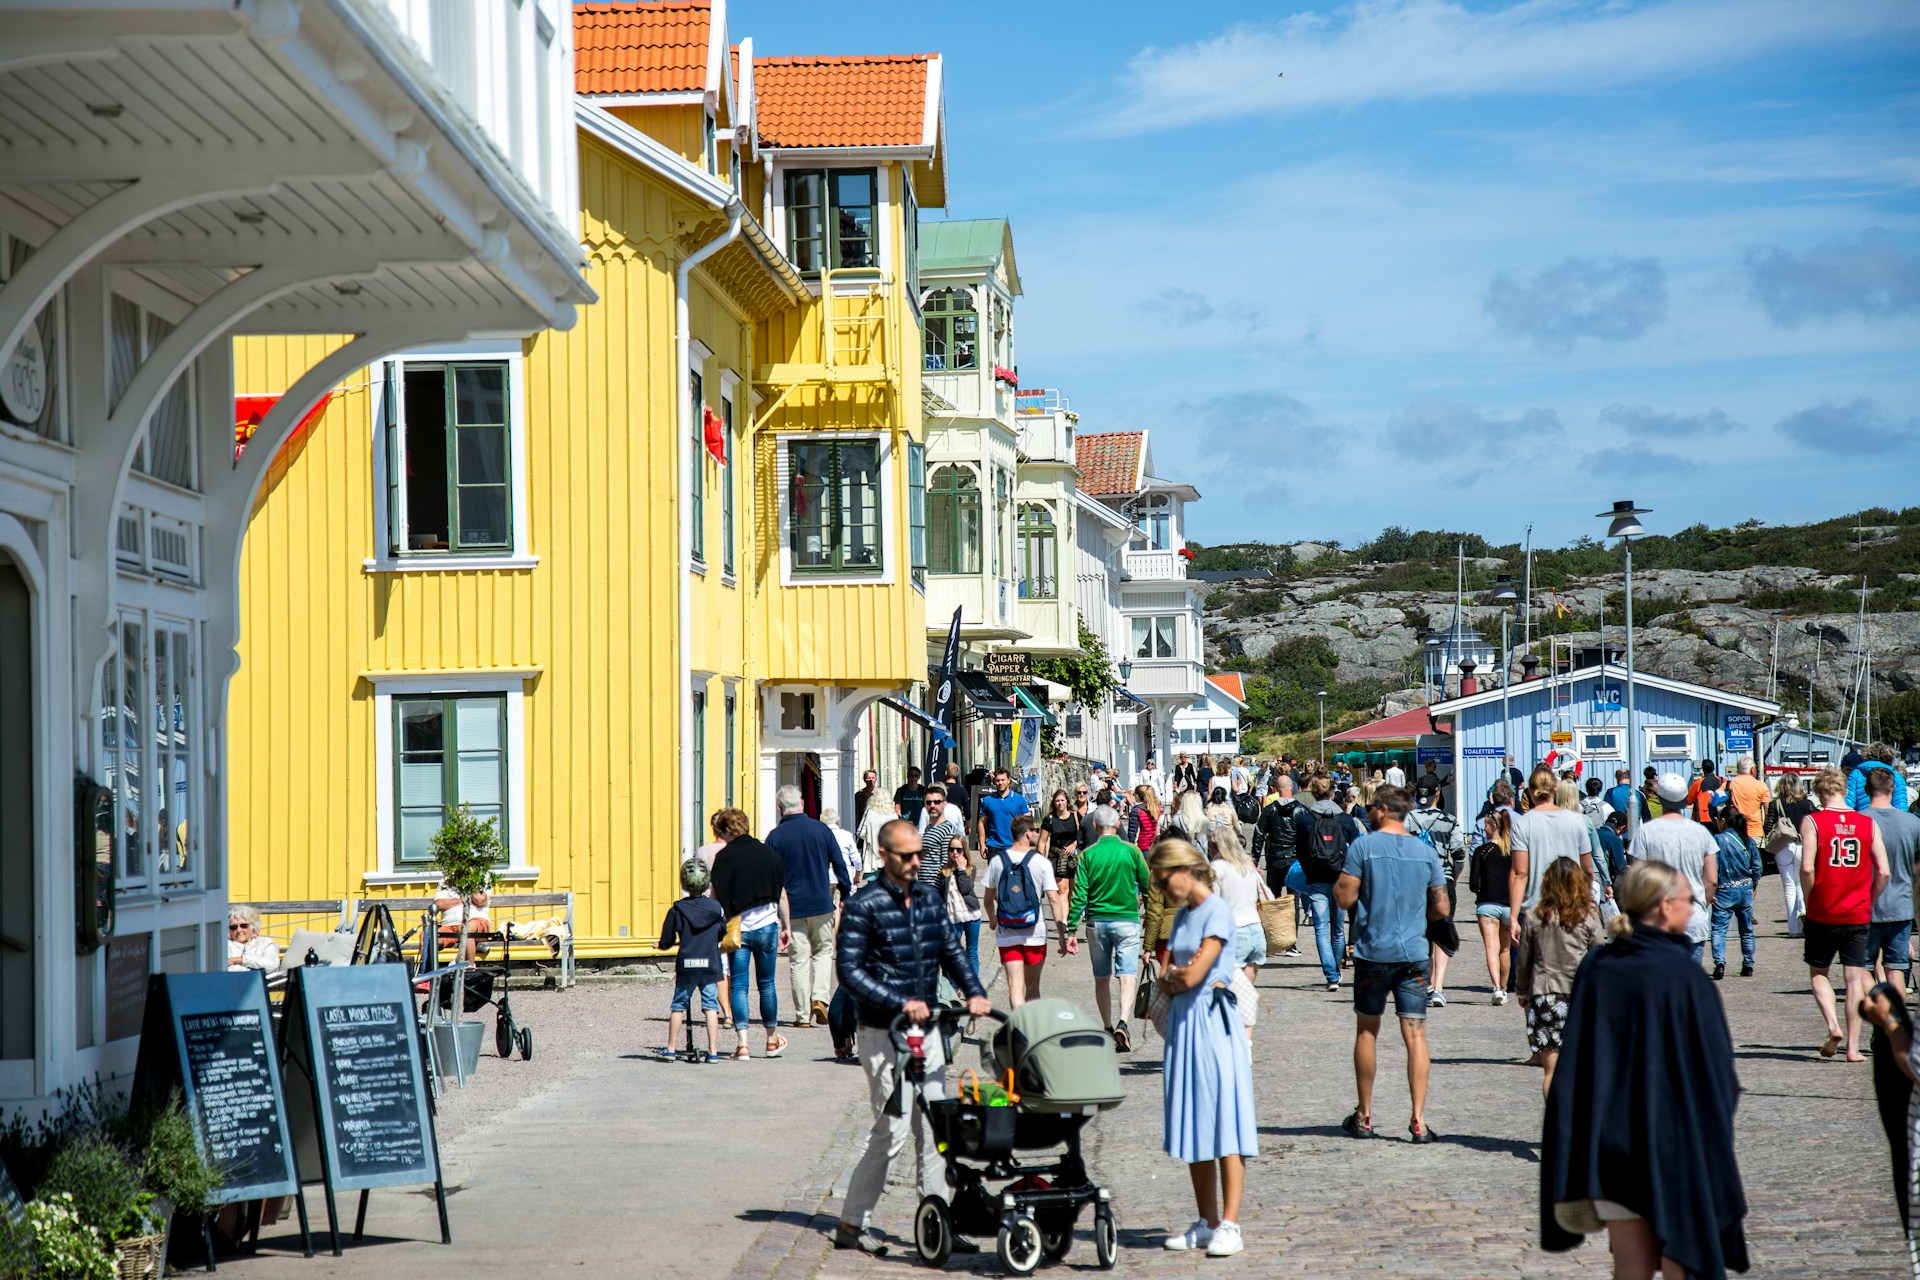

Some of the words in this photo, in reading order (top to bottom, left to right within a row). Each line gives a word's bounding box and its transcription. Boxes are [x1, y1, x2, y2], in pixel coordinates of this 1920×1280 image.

[990, 653, 1026, 664] CIGARR
[987, 663, 1020, 674] PAPPER
[1596, 689, 1620, 704] WC
[1731, 729, 1749, 737] MÜLL
[1829, 836, 1861, 868] 13
